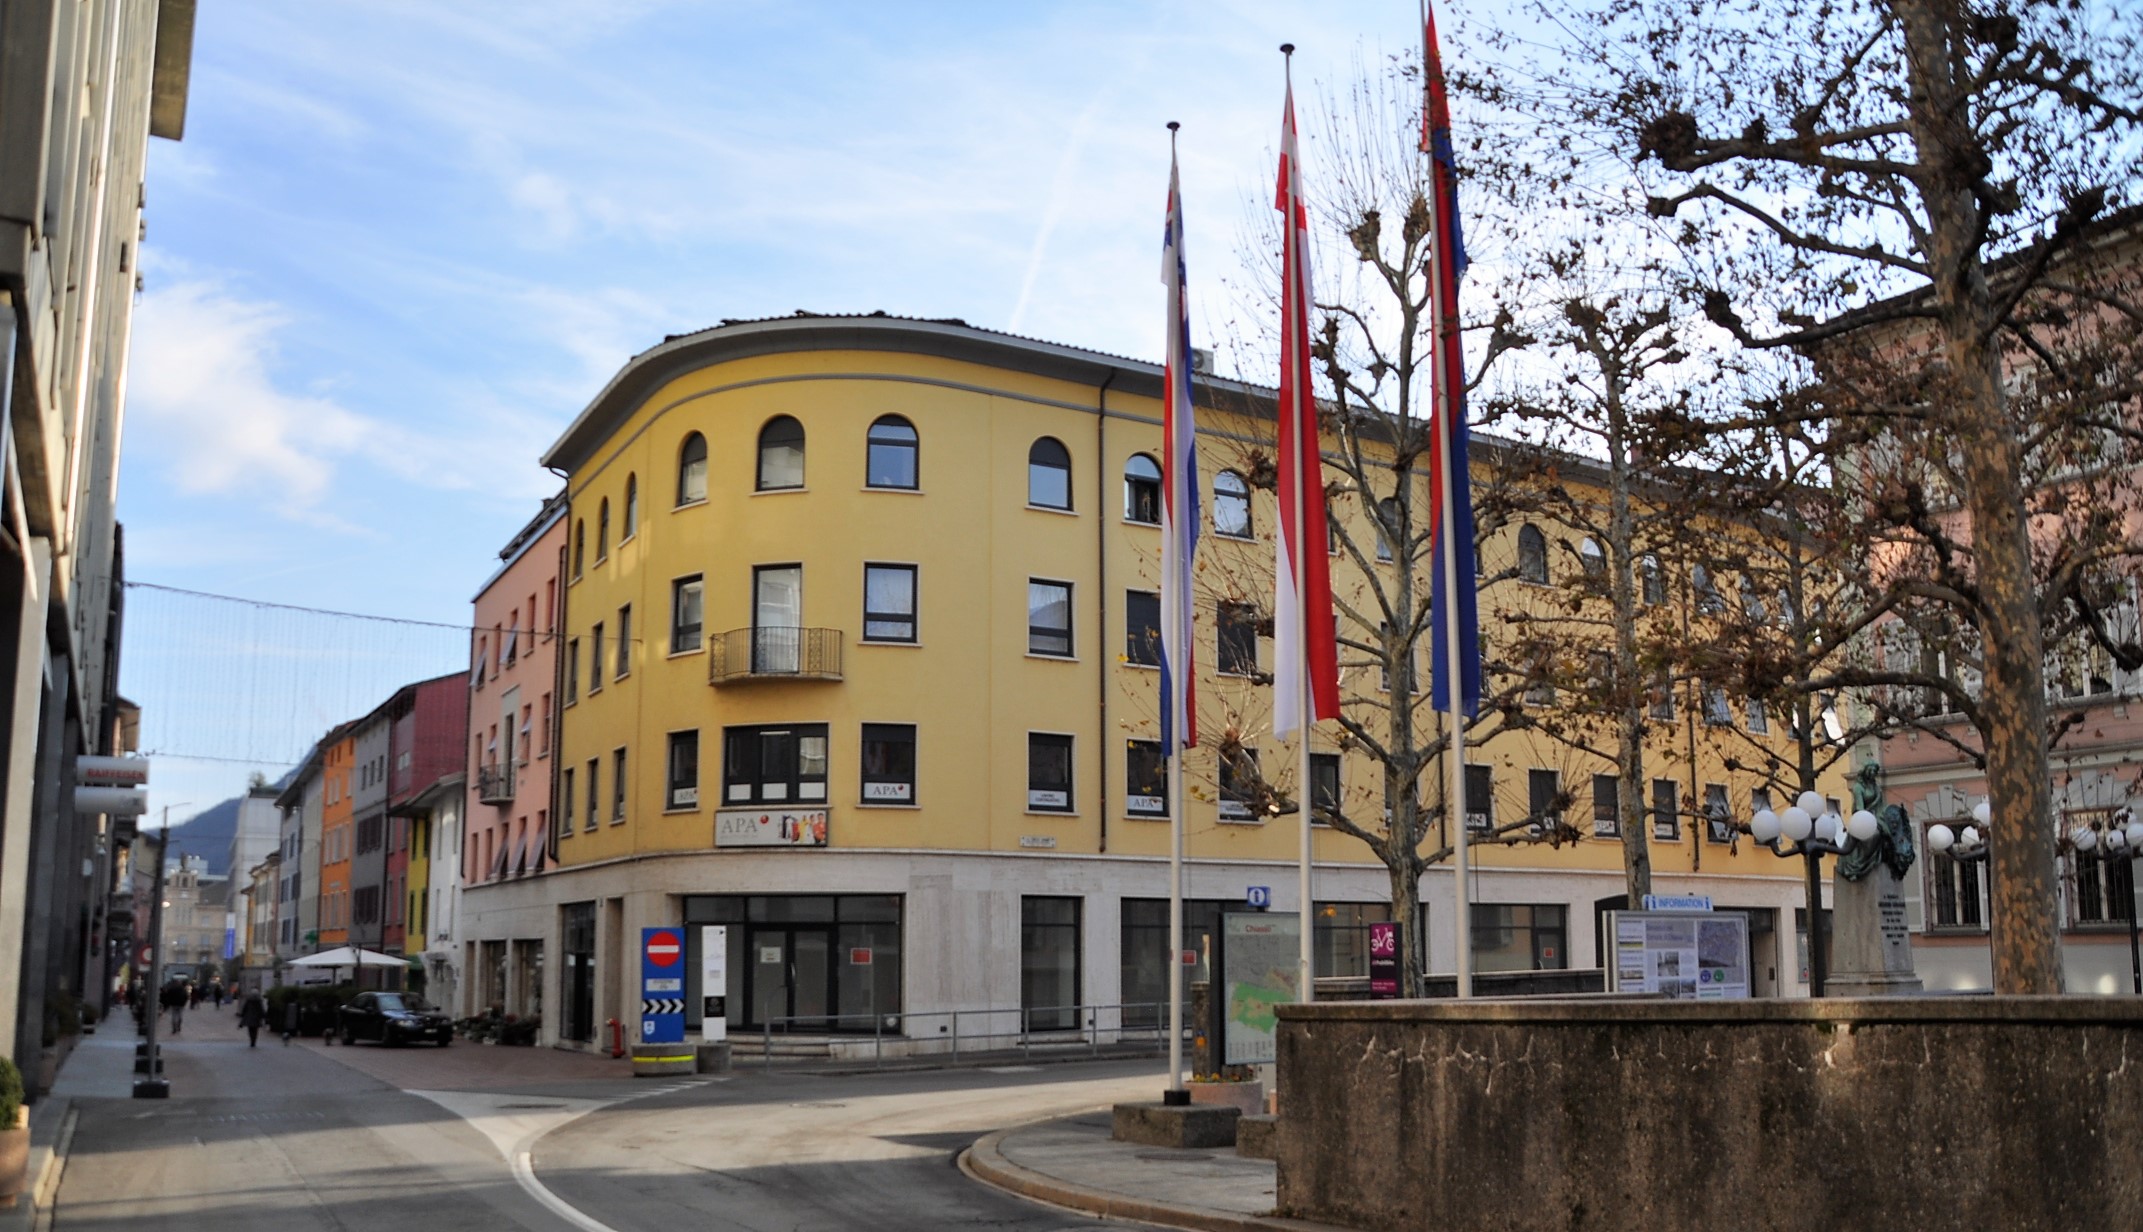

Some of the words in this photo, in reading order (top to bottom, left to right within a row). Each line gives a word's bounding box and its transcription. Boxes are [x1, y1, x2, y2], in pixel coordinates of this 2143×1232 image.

[873, 785, 898, 795] APA
[721, 818, 757, 833] APA
[1658, 898, 1704, 908] INFORMATION
